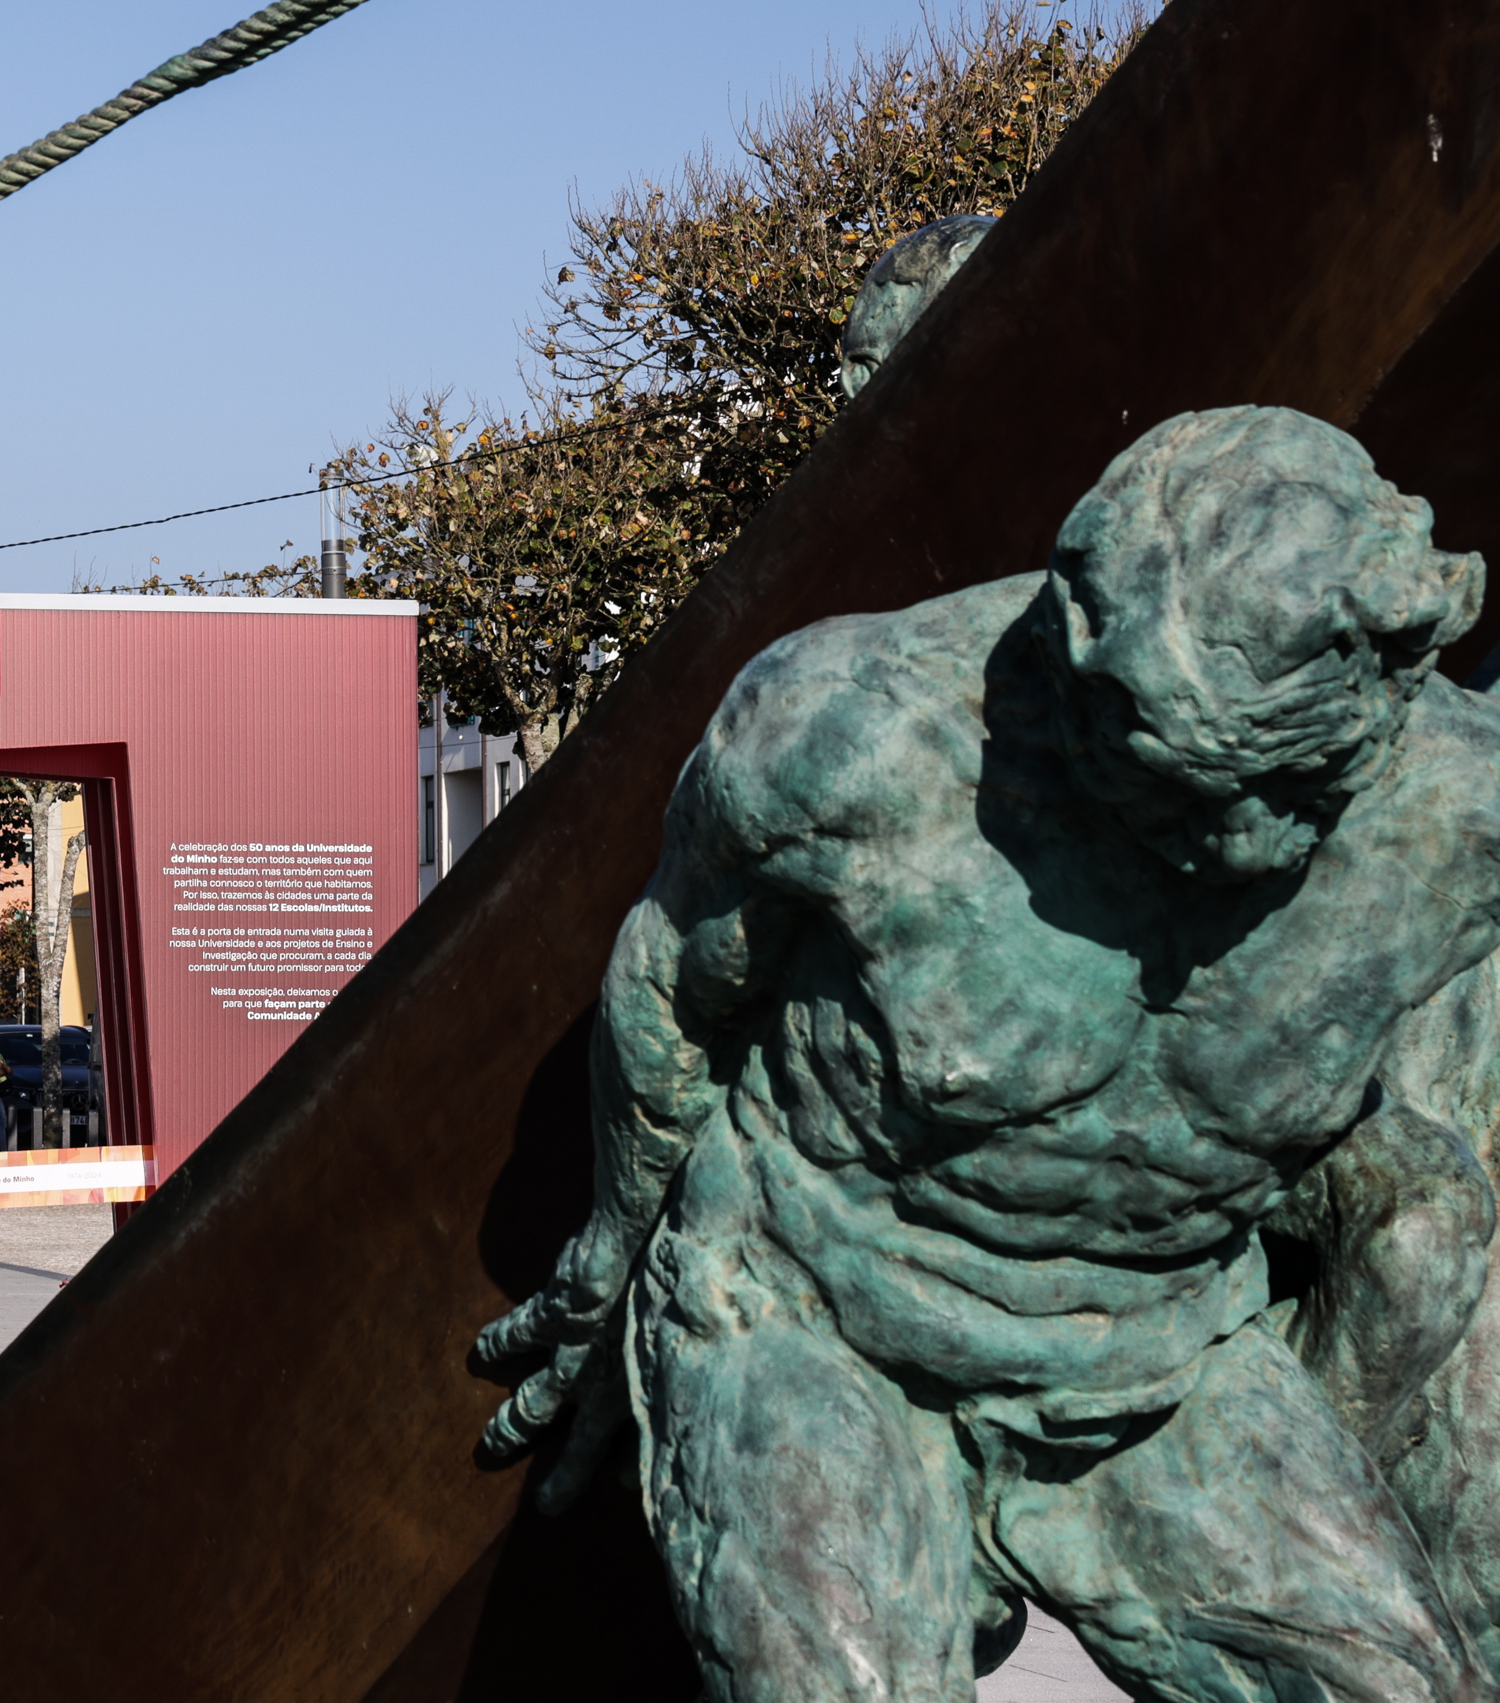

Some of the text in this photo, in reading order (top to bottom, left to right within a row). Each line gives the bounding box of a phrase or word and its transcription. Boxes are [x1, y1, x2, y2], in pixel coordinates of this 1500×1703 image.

[170, 842, 373, 853] A celebração dos 50 anos da Universidade
[170, 853, 373, 866] do Minho faz-se com todos aqueles que aqui
[162, 866, 373, 878] trabalham e estudam, mas também com quem
[173, 878, 373, 890] partilha connosco o território que habitamos.
[183, 890, 373, 902] Por isso, trazemos às cidades uma parte da
[173, 902, 374, 913] realidade das nossas 12 Escolas/Institutos.
[171, 926, 373, 938] Esta é a porta de entrada numa visita guiada à
[169, 938, 373, 950] nossa Universidade e aos projetos de Ensino e
[202, 951, 372, 962] Investigação que procuram, a cada dia
[188, 962, 229, 972] construir
[230, 964, 246, 972] um
[247, 962, 275, 972] futuro
[277, 963, 323, 974] promissor
[324, 964, 345, 974] para
[210, 986, 339, 998] Nesta exposição, deixamos o
[222, 998, 326, 1010] para que façam parte
[247, 1011, 313, 1021] Comunidade
[3, 1176, 11, 1184] do
[13, 1175, 35, 1183] Minho
[67, 1171, 102, 1180] 1974-2024
